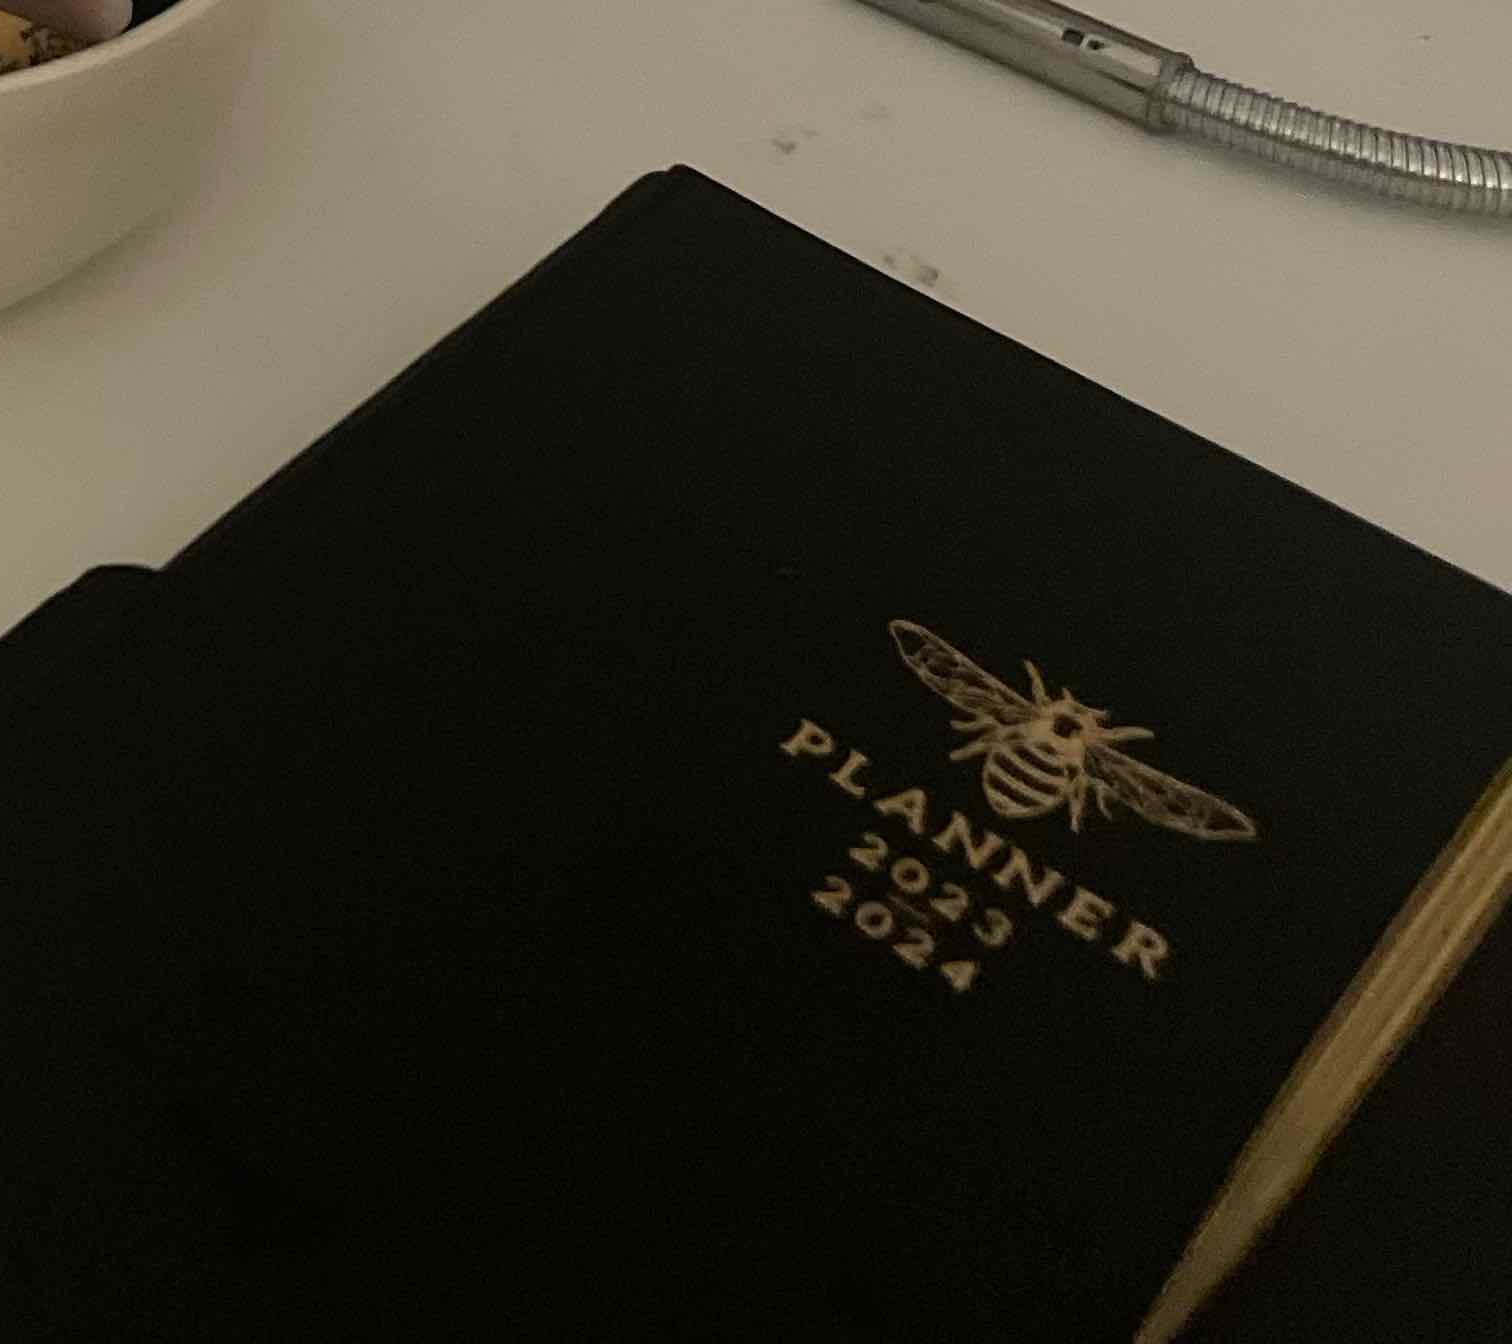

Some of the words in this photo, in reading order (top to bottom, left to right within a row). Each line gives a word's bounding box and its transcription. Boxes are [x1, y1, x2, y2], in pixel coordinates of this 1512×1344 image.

[780, 718, 1171, 982] PLANNER
[850, 832, 1014, 950] 2023
[811, 874, 982, 993] 2024
